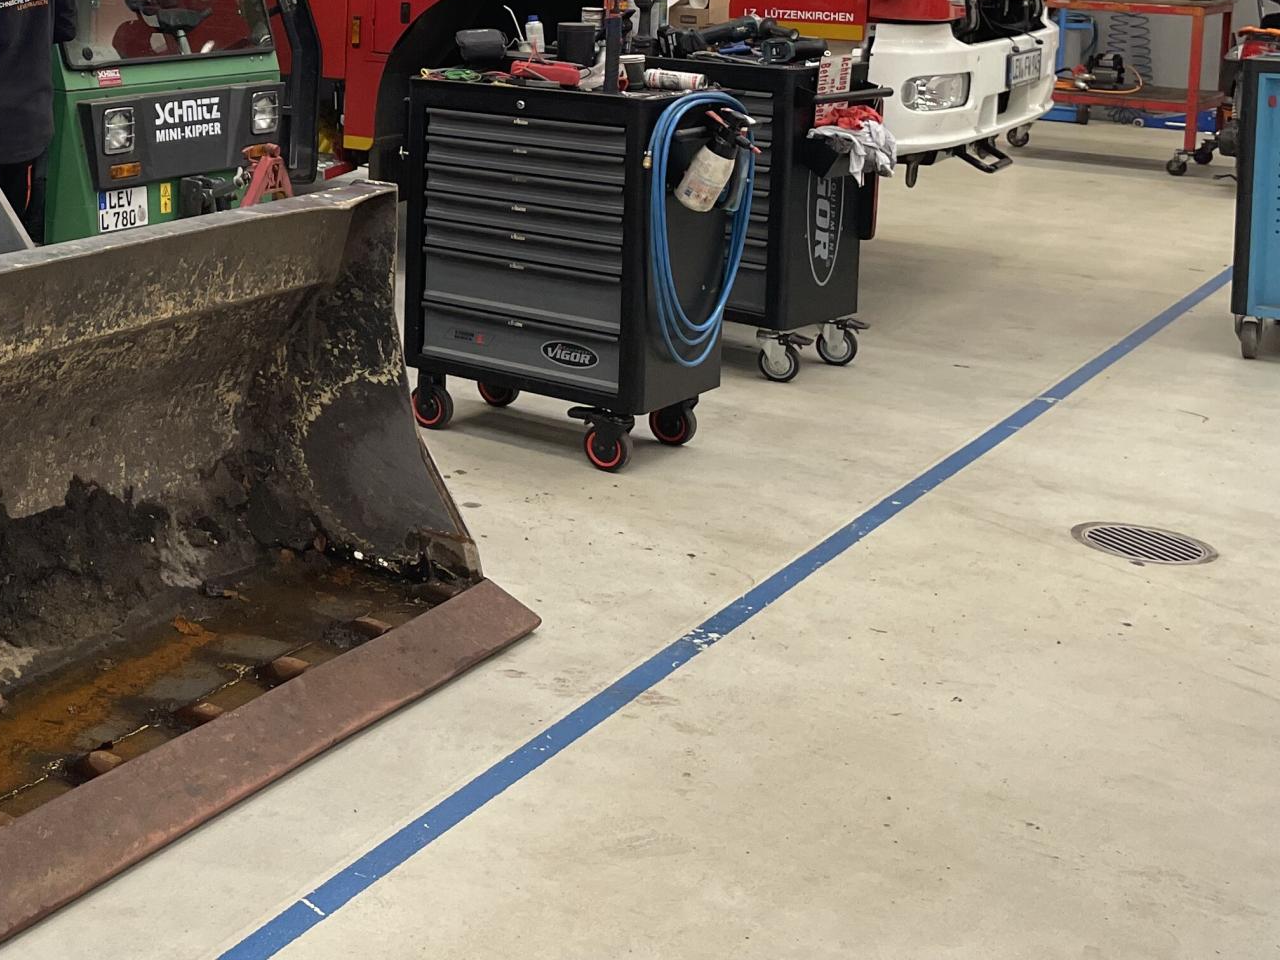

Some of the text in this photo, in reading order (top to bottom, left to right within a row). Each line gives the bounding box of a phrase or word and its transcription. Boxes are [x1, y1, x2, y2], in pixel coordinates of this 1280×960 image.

[764, 7, 855, 22] LÜTZENKIRCHEN
[836, 57, 852, 91] Achtung
[155, 122, 222, 142] MINI-KIPPER
[109, 189, 133, 209] LEV
[101, 209, 137, 230] L 780
[548, 344, 591, 365] VIGOR
